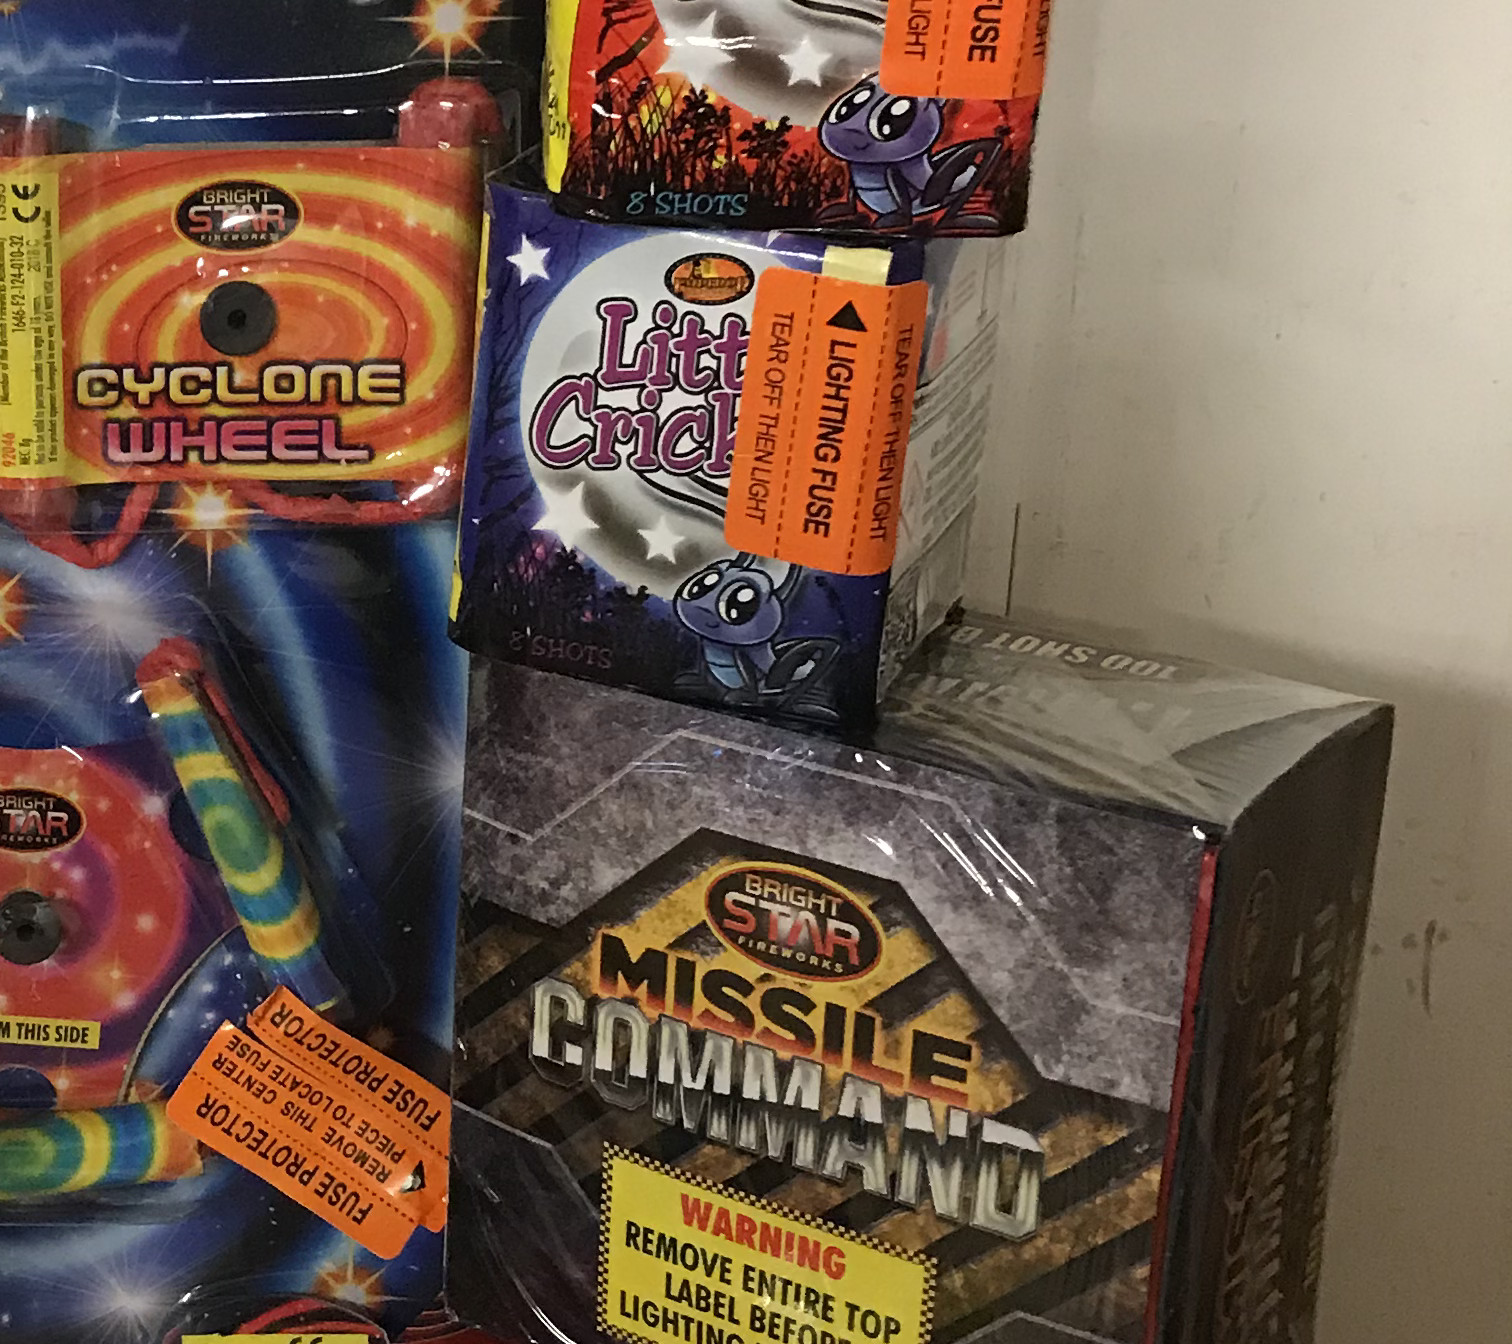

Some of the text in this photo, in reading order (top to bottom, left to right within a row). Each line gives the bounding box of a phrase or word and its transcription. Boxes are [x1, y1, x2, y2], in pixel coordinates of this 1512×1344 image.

[188, 204, 287, 233] STAR
[203, 188, 272, 205] BRIGHT
[626, 191, 749, 217] 8 SHOTS
[597, 296, 750, 392] Litt
[891, 323, 915, 380] TEAR
[75, 362, 403, 407] CYCLONE
[105, 419, 373, 465] WHEEL
[745, 311, 795, 525] TEAR OFF THEN LIGHT
[802, 339, 855, 537] LIGHTING FUSE
[1, 432, 16, 468] 92046
[877, 427, 902, 483] THEN
[869, 485, 894, 542] LIGHT
[510, 631, 612, 668] 8 SHOTS
[982, 632, 1097, 664] SHOT
[743, 872, 845, 917] BRIGHT
[722, 889, 861, 966] STAR
[738, 935, 845, 974] FIREWORKS
[15, 1020, 52, 1042] THIS
[56, 1022, 90, 1044] SIDE
[597, 931, 973, 1107] MISSILE
[269, 1001, 441, 1132] FUSE PROTECTOR
[211, 1053, 392, 1184] REMOVE THIS CENTER
[225, 1035, 406, 1164] PIECE TO LOCATE FUSE
[529, 976, 1046, 1242] COMMAND
[196, 1093, 374, 1225] FUSE PROTECTOR
[680, 1193, 847, 1280] WARNING
[625, 1220, 901, 1344] REMOVE ENTIRE TOP
[665, 1271, 741, 1327] LABEL
